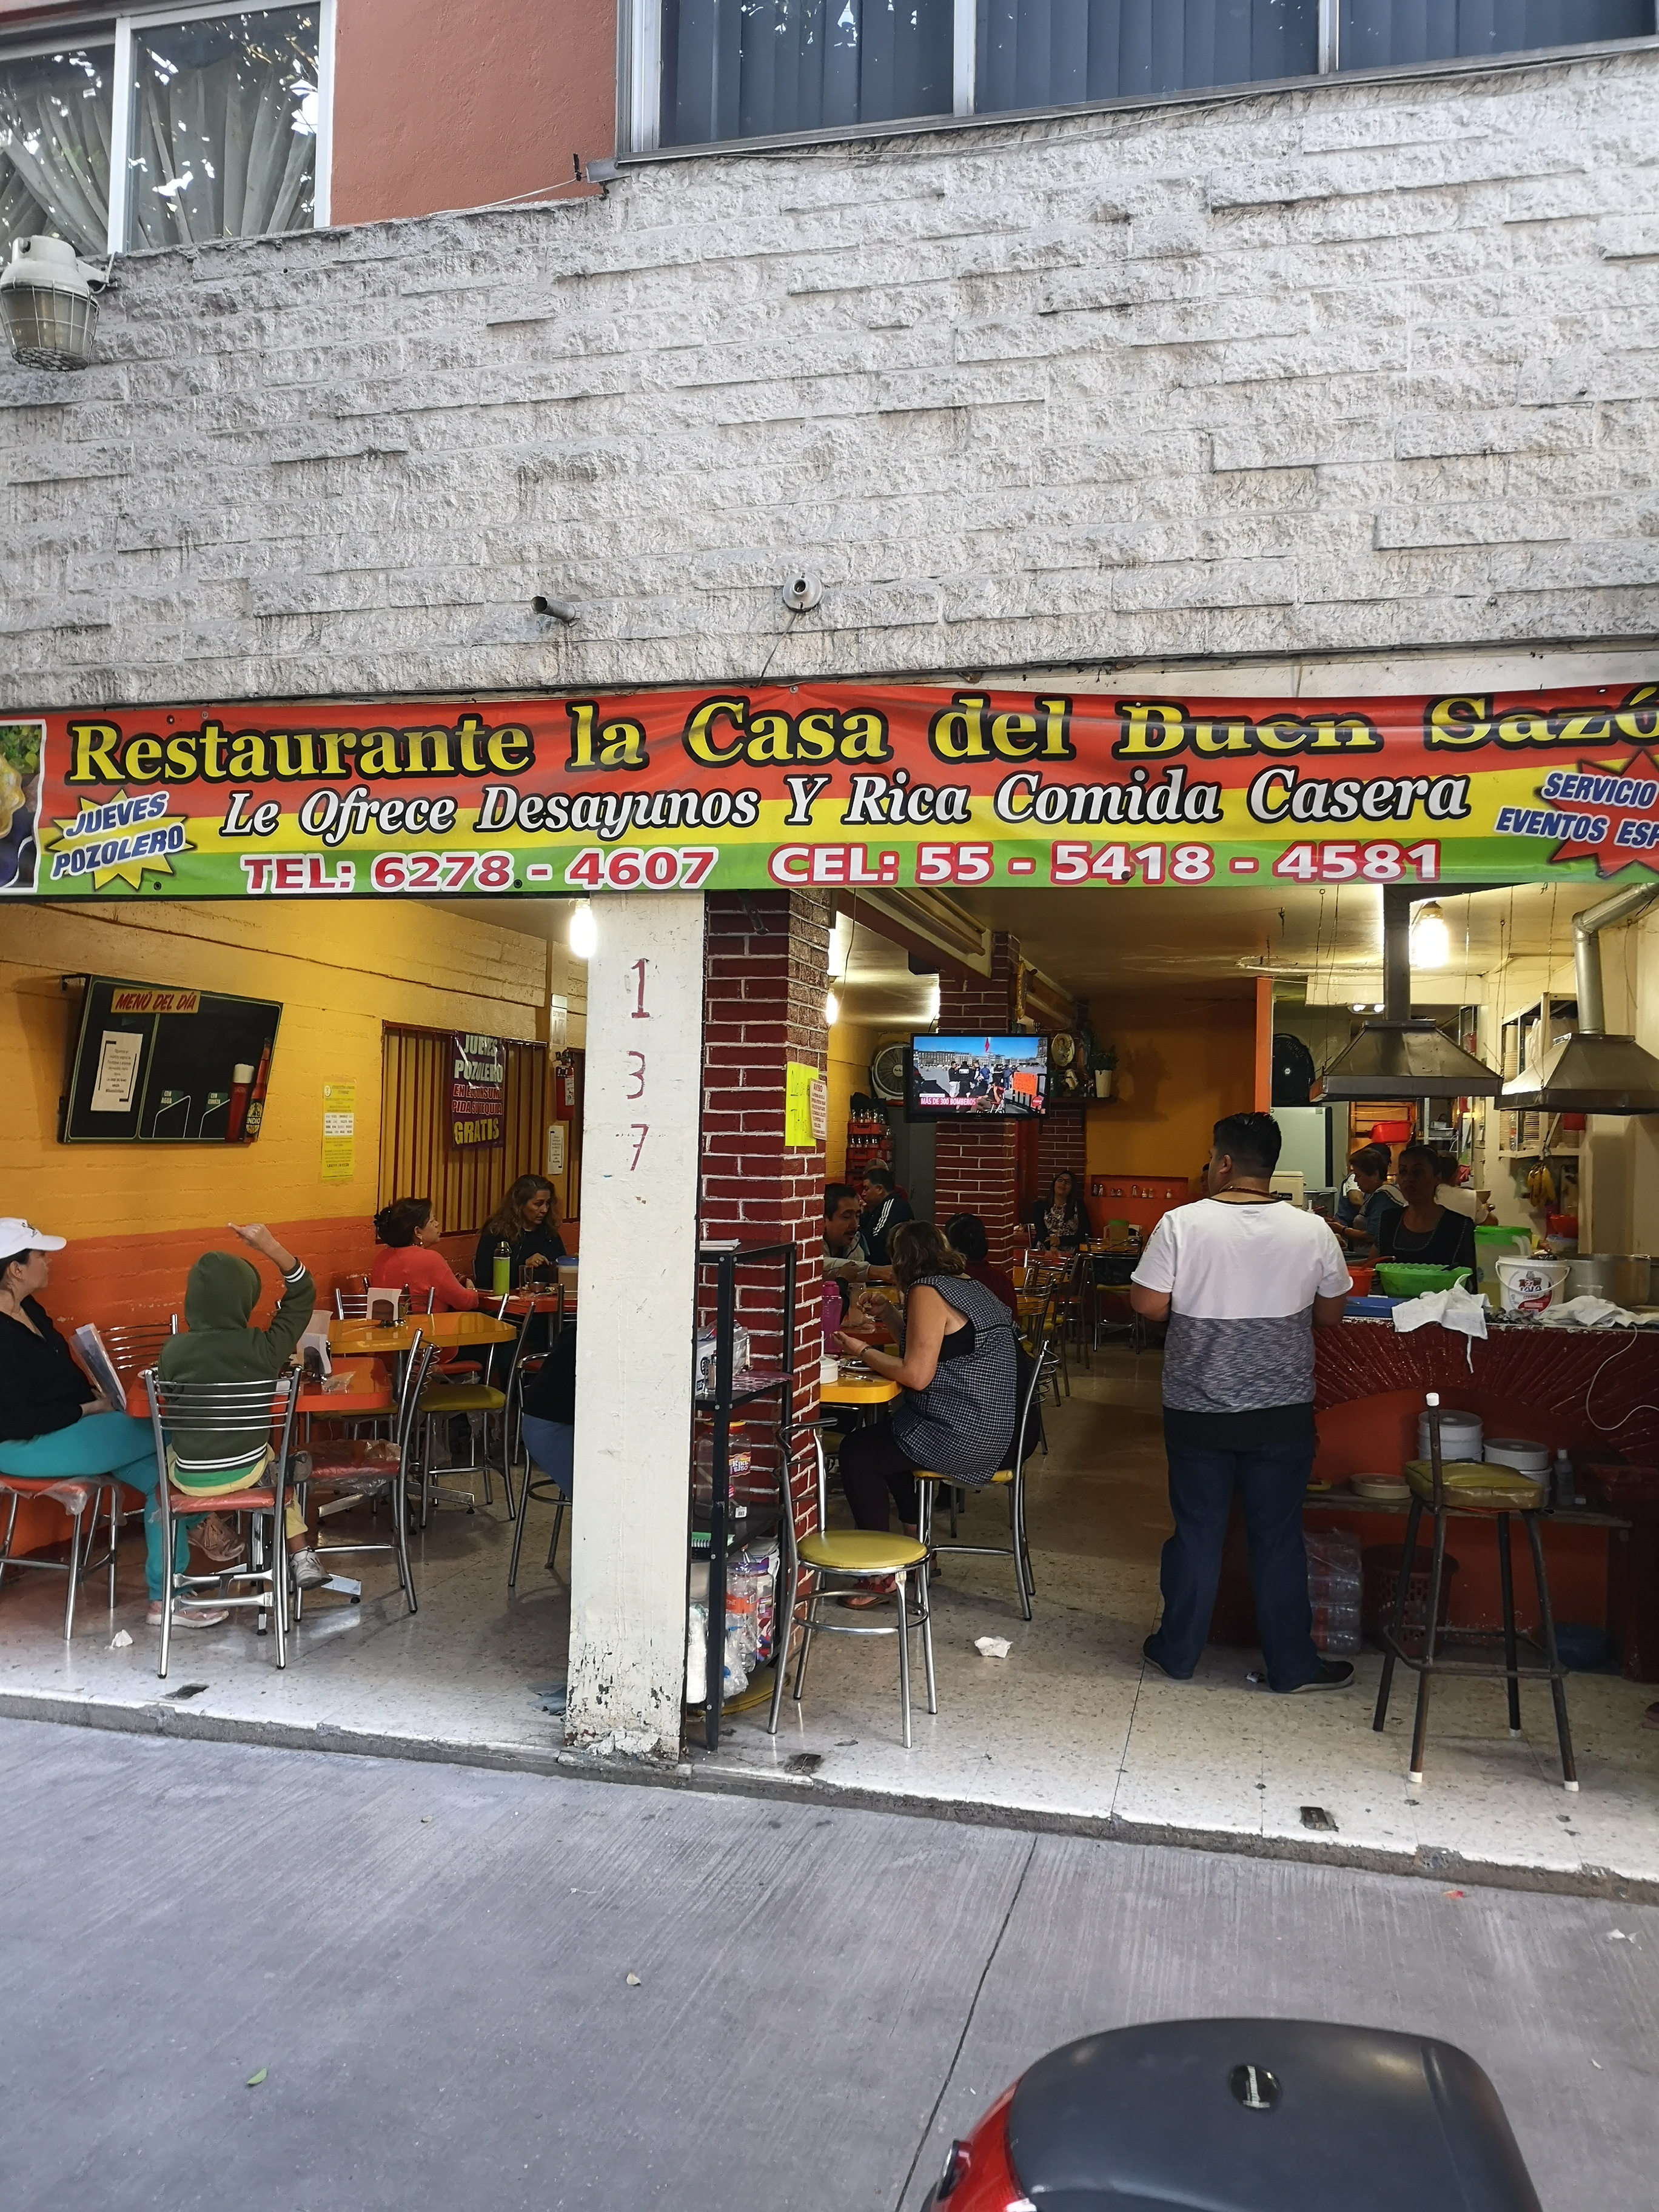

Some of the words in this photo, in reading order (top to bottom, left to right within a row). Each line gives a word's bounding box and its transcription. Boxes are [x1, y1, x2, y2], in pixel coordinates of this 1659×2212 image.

[67, 716, 532, 783] Restaurante
[567, 702, 647, 770] la
[685, 698, 891, 765] Casa
[931, 695, 1073, 761] del
[1115, 703, 1381, 756] Buen
[220, 791, 280, 835] Le
[300, 786, 456, 845] Ofrece
[475, 786, 759, 839] Desayunos
[785, 776, 830, 823] Y
[842, 769, 970, 823] Rica
[995, 766, 1221, 823] Comida
[1249, 766, 1469, 821] Casera
[1543, 771, 1658, 808] SERVICIO
[64, 793, 168, 838] JUEVES
[1495, 806, 1609, 842] EVENTOS
[51, 823, 184, 878] POZOLERO
[770, 845, 896, 883] CEL:
[917, 845, 991, 883] 55
[1054, 843, 1212, 882] 5418
[1275, 841, 1438, 880] 4581
[243, 856, 352, 891] TEL:
[372, 854, 512, 889] 6278
[567, 850, 716, 887] 4607
[115, 991, 153, 1010] MENÚ
[153, 994, 175, 1011] DEL
[176, 991, 197, 1011] DÍA
[464, 1034, 498, 1057] JUEVES
[454, 1059, 503, 1083] POZOLERO
[452, 1100, 471, 1114] PIDA
[453, 1084, 466, 1098] EN
[920, 1096, 932, 1105] MÁS
[454, 1118, 500, 1145] GRATIS
